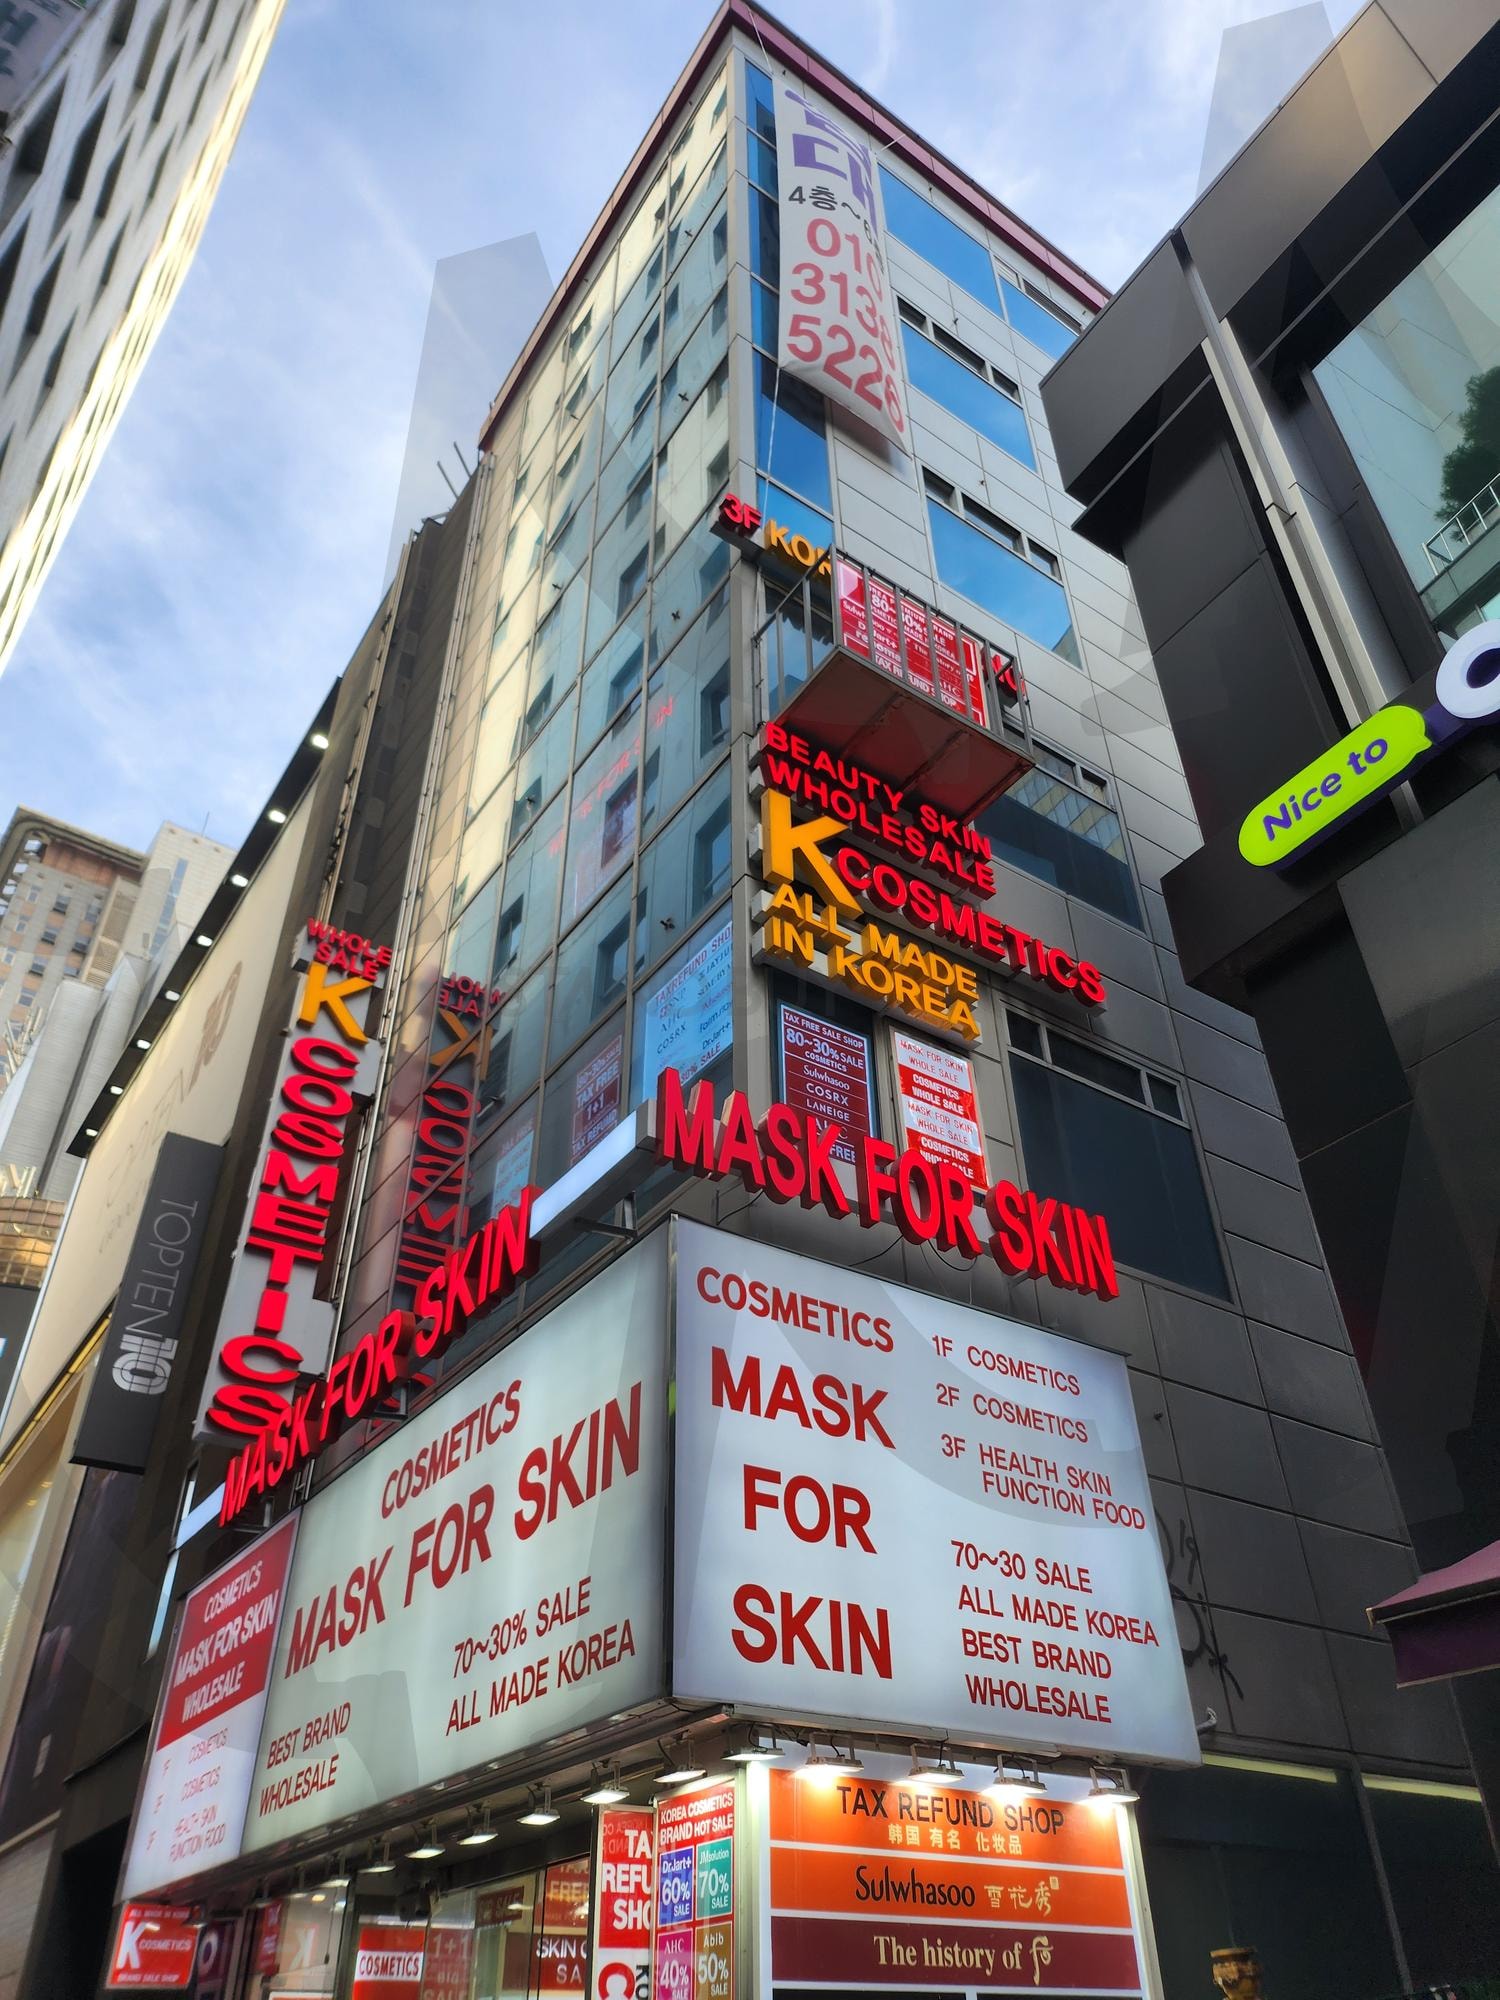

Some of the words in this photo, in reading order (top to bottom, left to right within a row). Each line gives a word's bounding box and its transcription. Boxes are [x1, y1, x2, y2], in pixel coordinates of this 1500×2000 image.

[806, 218, 882, 303] 010
[722, 492, 762, 528] 3F
[766, 721, 904, 812] BEAUTY
[920, 804, 992, 861] SKIN
[1261, 771, 1343, 842] Nice
[1346, 737, 1390, 776] to
[767, 754, 997, 897] WHOLESALE
[761, 787, 864, 917] K
[836, 847, 1106, 1007] COSMETICS
[306, 916, 394, 968] WHOLE
[315, 942, 381, 983] SALE
[766, 884, 851, 945] ALL
[863, 923, 979, 1000] MADE
[298, 961, 375, 1046] K
[766, 916, 813, 968] IN
[830, 946, 981, 1041] KOREA
[785, 1012, 800, 1025] TAX
[802, 1018, 820, 1033] FREE
[822, 1025, 841, 1040] SALE
[843, 1034, 863, 1049] SHOP
[786, 1028, 840, 1060] 80~30%
[840, 1053, 864, 1070] SALE
[803, 1064, 850, 1091] Sulwhasoo
[804, 1050, 847, 1072] COSMETICS
[900, 1039, 923, 1056] MASK
[926, 1050, 942, 1064] FOR
[945, 1056, 964, 1074] SKIN
[908, 1055, 936, 1074] WHOLE
[938, 1068, 959, 1084] SALE
[806, 1083, 849, 1107] COSRX
[806, 1098, 850, 1122] LANEIGE
[912, 1073, 960, 1101] COSMETICS
[912, 1085, 941, 1106] WHOLE
[943, 1098, 965, 1115] SALE
[907, 1101, 932, 1118] MASK
[935, 1110, 951, 1125] FOR
[953, 1118, 973, 1135] SKIN
[916, 1117, 945, 1136] WHOLE
[947, 1128, 969, 1146] SALE
[920, 1136, 970, 1163] COSMETICS
[657, 1066, 852, 1220] MASK
[858, 1136, 983, 1260] FOR
[984, 1180, 1120, 1302] SKIN
[206, 1036, 363, 1438] COSMETICS
[125, 1199, 199, 1338] TOPTEN
[696, 1266, 895, 1354] COSMETICS
[218, 1382, 318, 1528] MASK
[319, 1309, 405, 1442] FOR
[414, 1184, 543, 1358] SKIN
[931, 1334, 955, 1359] 1F
[967, 1344, 1082, 1396] COSMETICS
[710, 1345, 897, 1451] MASK
[935, 1382, 961, 1407] 2F
[973, 1393, 1089, 1444] COSMETICS
[381, 1380, 523, 1520] COSMETICS
[940, 1433, 966, 1459] 3F
[979, 1442, 1059, 1484] HEALTH
[1066, 1465, 1113, 1497] SKIN
[742, 1463, 878, 1555] FOR
[982, 1470, 1086, 1518] FUNCTION
[1092, 1499, 1147, 1530] FOOD
[284, 1545, 394, 1680] MASK
[403, 1483, 496, 1609] FOR
[514, 1381, 643, 1541] SKIN
[203, 1560, 263, 1624] COSMETICS
[950, 1540, 1026, 1580] 70~30
[1035, 1559, 1093, 1594] SALE
[173, 1632, 215, 1689] MASK
[211, 1615, 243, 1665] FOR
[240, 1589, 280, 1645] SKIN
[453, 1607, 528, 1679] 70~30%
[535, 1575, 593, 1637] SALE
[730, 1582, 894, 1680] SKIN
[958, 1584, 1004, 1617] ALL
[1012, 1592, 1079, 1631] MADE
[1086, 1608, 1160, 1648] KOREA
[445, 1680, 483, 1737] ALL
[489, 1655, 549, 1720] MADE
[557, 1618, 636, 1687] KOREA
[961, 1627, 1024, 1664] BEST
[1032, 1638, 1113, 1680] BRAND
[181, 1660, 246, 1723] WHOLESALE
[965, 1673, 1113, 1724] WHOLESALE
[266, 1726, 301, 1771] BEST
[302, 1701, 352, 1753] BRAND
[259, 1752, 340, 1819] WHOLESALE
[660, 1805, 688, 1825] KOREA
[687, 1793, 734, 1817] COSMETICS
[836, 1786, 889, 1819] TAX
[899, 1791, 994, 1829] REFUND
[1003, 1803, 1065, 1836] SHOP
[660, 1821, 693, 1846] BRAND
[694, 1820, 711, 1838] HOT
[711, 1813, 734, 1834] SALE
[887, 1823, 921, 1847] 韩国
[928, 1827, 961, 1850] 有名
[975, 1831, 1023, 1856] 化妆品
[661, 1876, 690, 1906] 60%
[662, 1856, 692, 1875] Dr.Jart+
[699, 1868, 729, 1899] 70%
[855, 1865, 976, 1908] Sulwhasoo
[673, 1903, 690, 1917] SALE
[711, 1895, 729, 1910] SALE
[115, 1921, 146, 1970] K
[359, 1953, 420, 1976] COSMETICS
[665, 1937, 685, 1954] AHC
[697, 1953, 729, 1984] 50%
[873, 1935, 918, 1967] The
[922, 1937, 996, 1976] history
[1002, 1941, 1023, 1971] of
[659, 1959, 690, 1990] 40%
[710, 1983, 729, 1997] SALE
